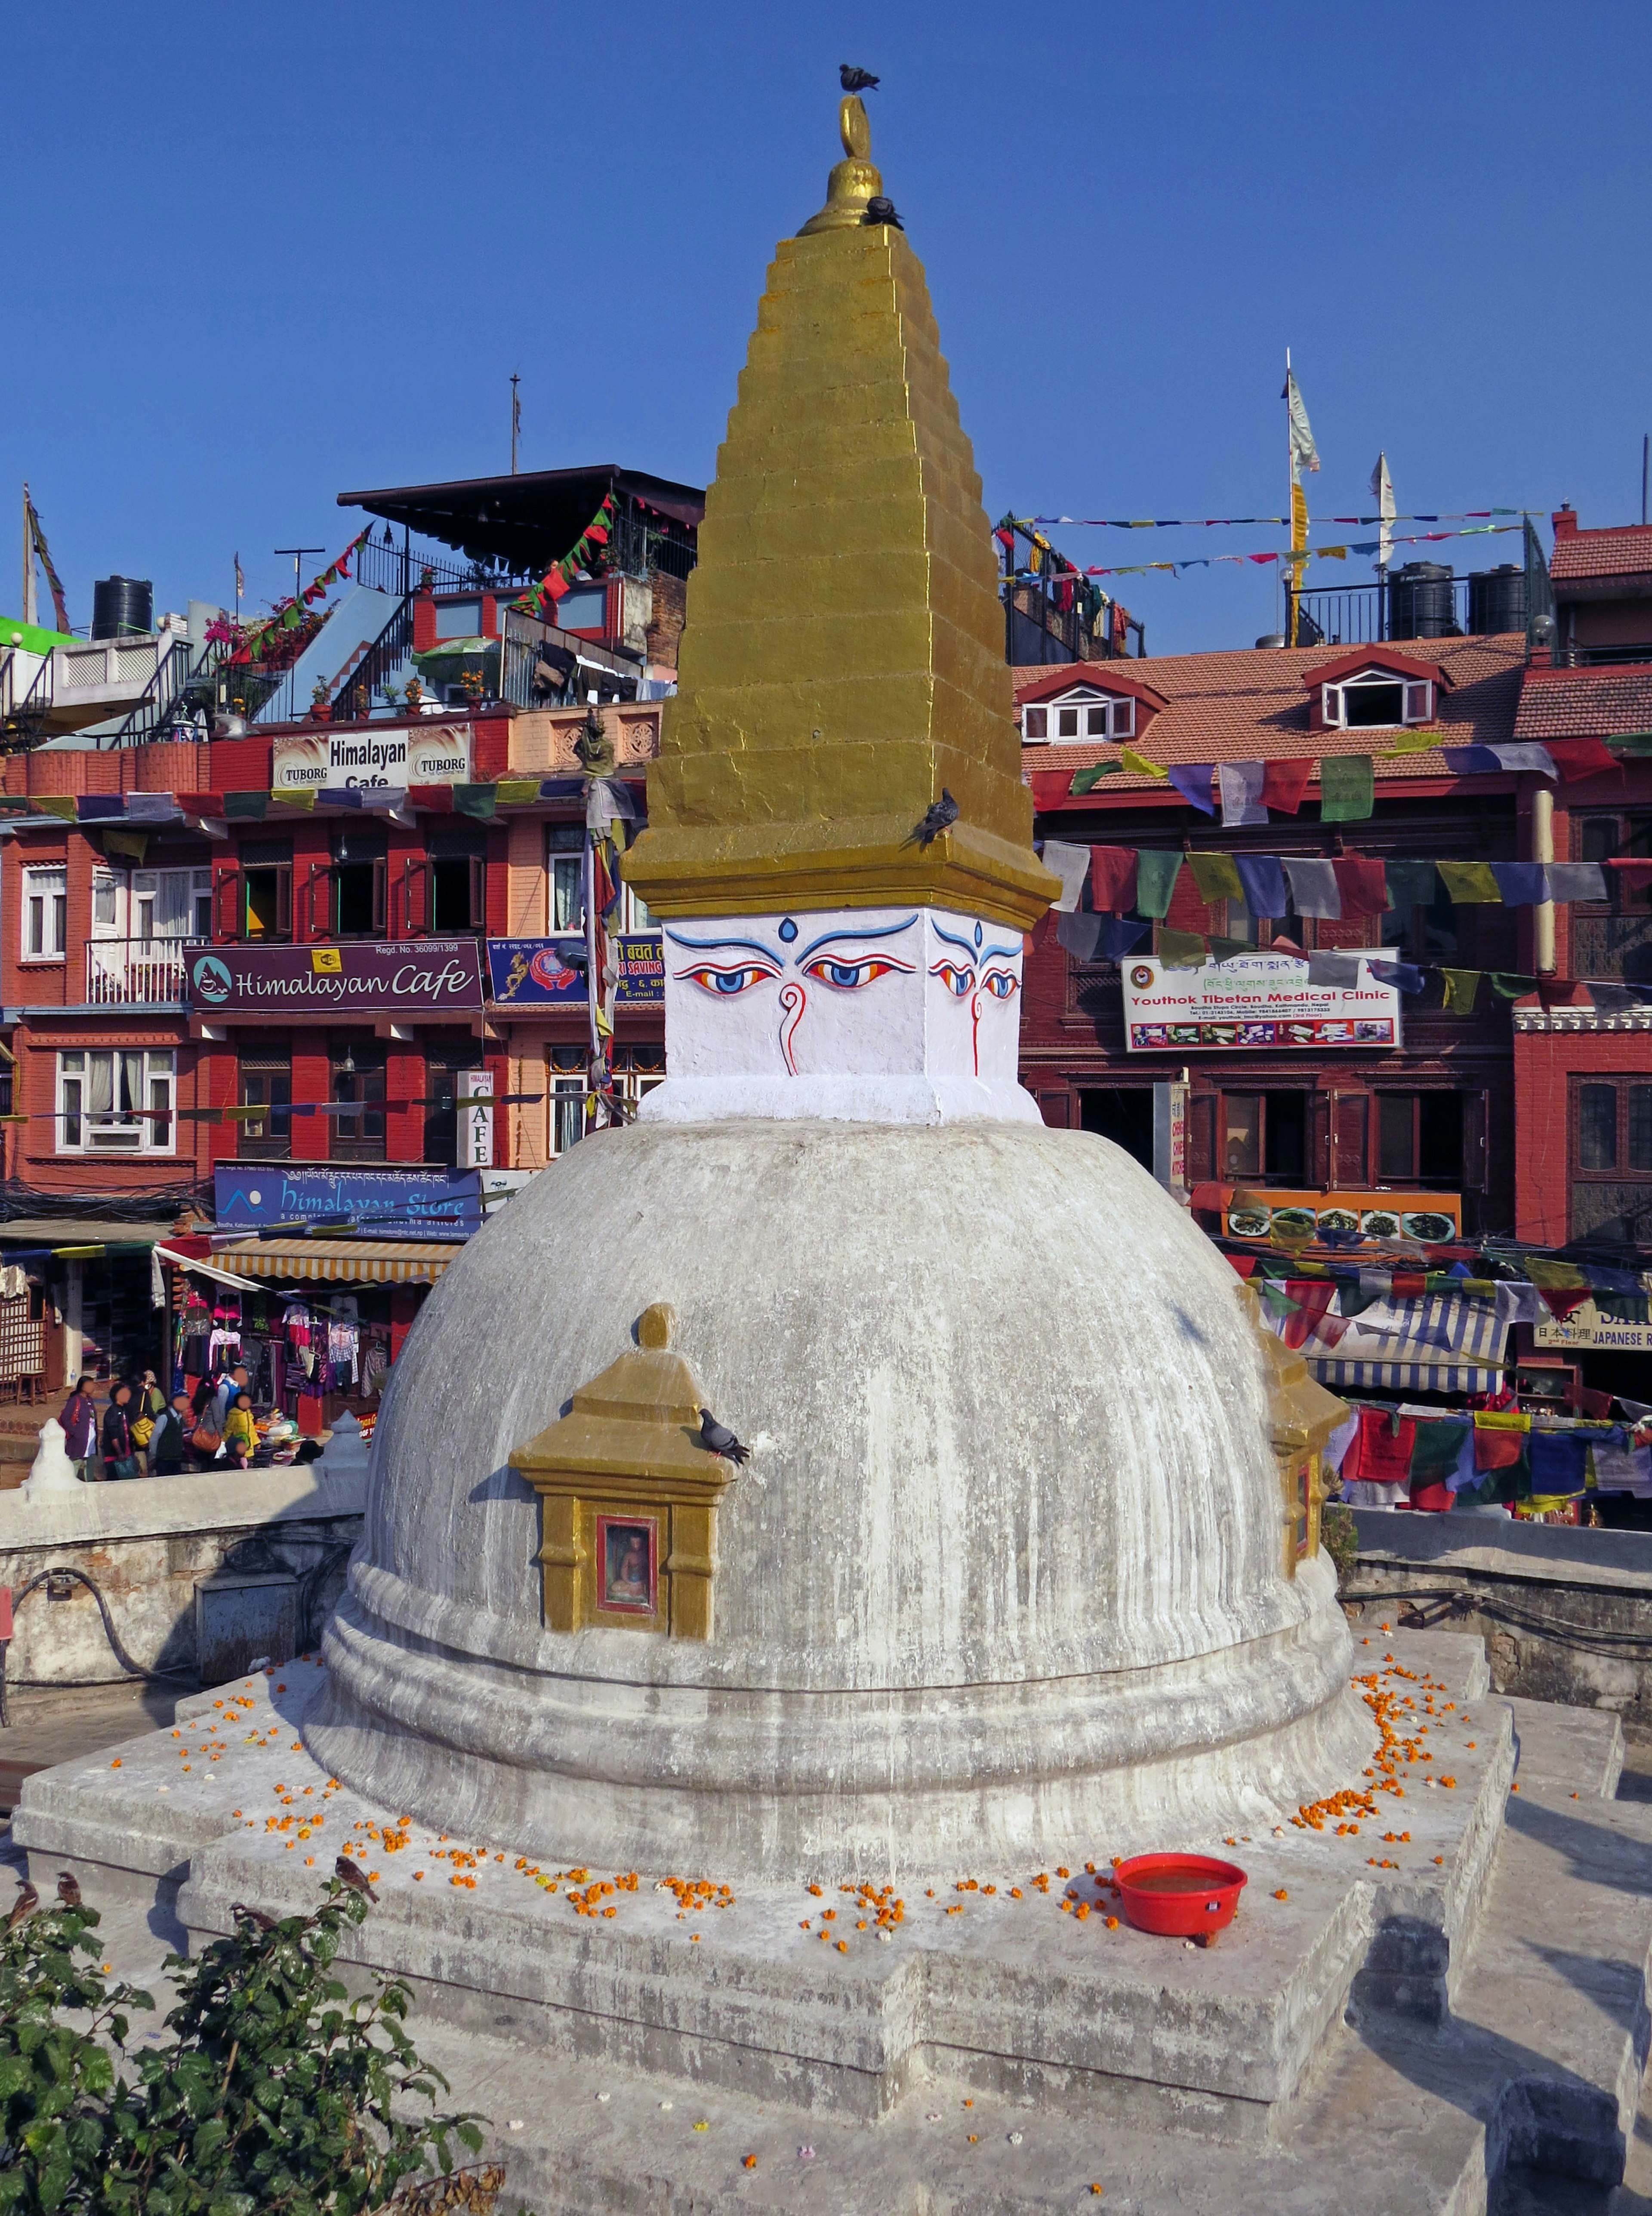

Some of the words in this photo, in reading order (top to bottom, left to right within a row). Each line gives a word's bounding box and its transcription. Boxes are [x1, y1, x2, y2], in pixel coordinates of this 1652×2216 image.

[331, 739, 406, 771] Himalayan
[421, 758, 465, 772] TUBORG
[286, 767, 327, 781] TUBORG
[345, 775, 388, 789] Cafe
[376, 946, 398, 955] Regd.
[414, 943, 458, 952] 36099/1399
[627, 943, 653, 960] बचत
[628, 961, 662, 975] SAVING
[236, 971, 389, 1002] Himalayan
[391, 959, 474, 1000] Cafe
[1131, 996, 1197, 1005] Youthok
[1202, 994, 1261, 1004] Tibetan
[1268, 992, 1336, 1002] Medical
[1342, 991, 1390, 999] Clinic
[1593, 1331, 1642, 1345] JAPANESE
